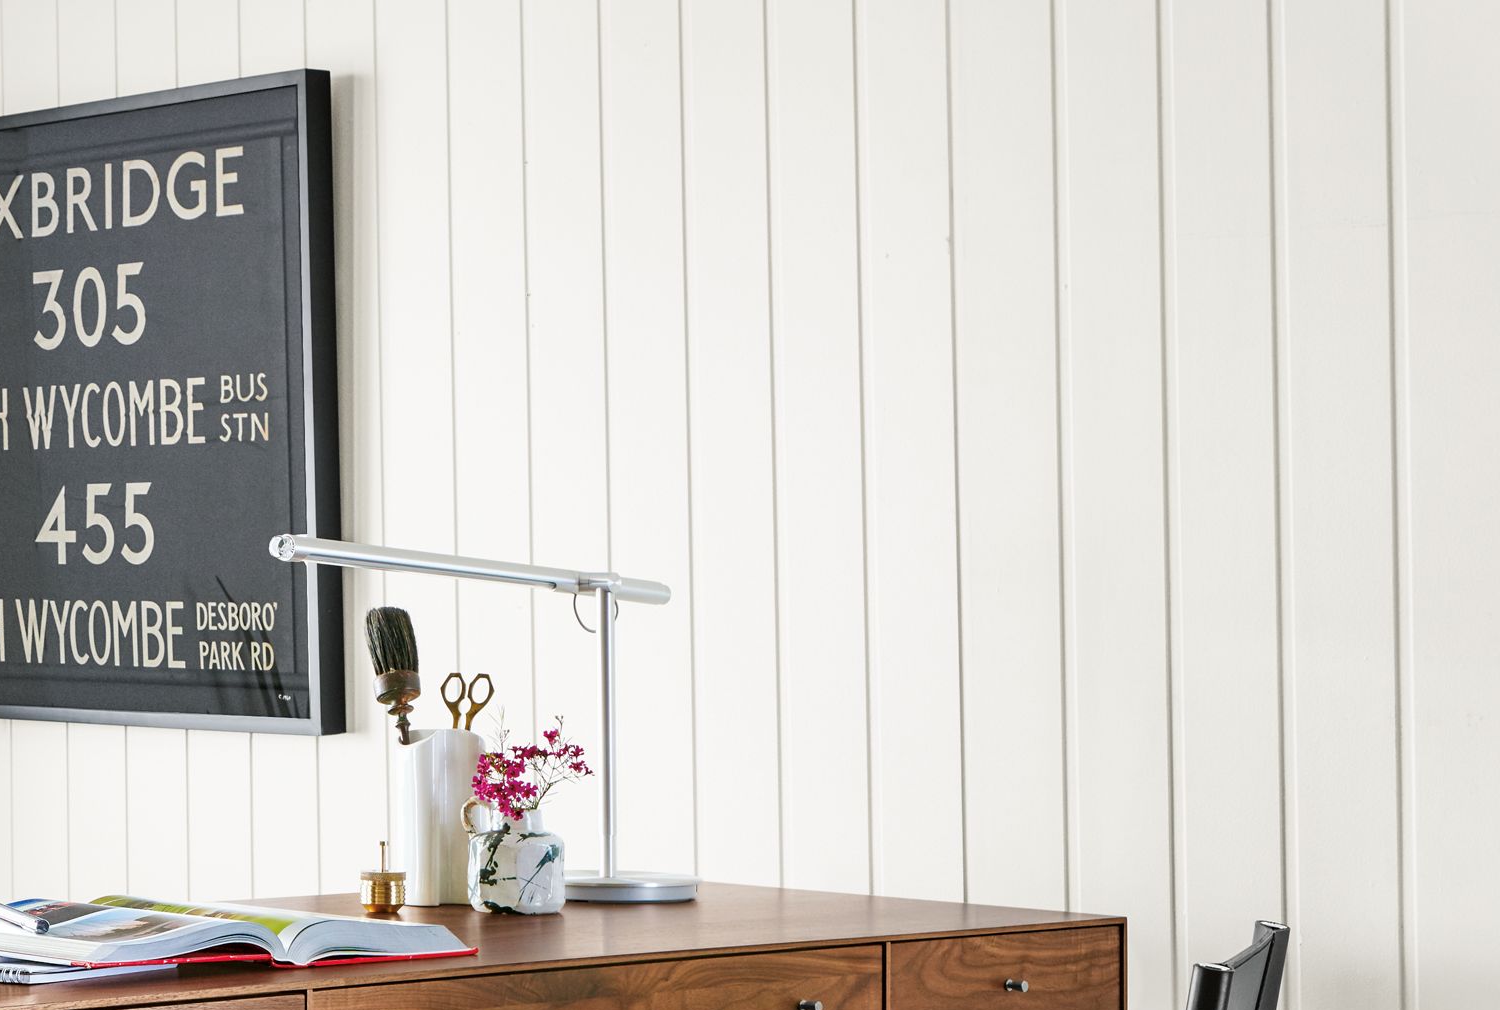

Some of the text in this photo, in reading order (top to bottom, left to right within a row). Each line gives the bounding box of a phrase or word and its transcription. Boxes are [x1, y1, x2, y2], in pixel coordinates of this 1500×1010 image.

[33, 261, 146, 350] 305
[22, 376, 206, 450] WYCOMBE
[219, 373, 268, 404] BUS
[219, 412, 269, 442] STN
[34, 481, 155, 566] 455
[15, 598, 187, 669] WYCOMBE
[195, 601, 278, 632] DESBORO'
[198, 640, 275, 671] PARK RD
